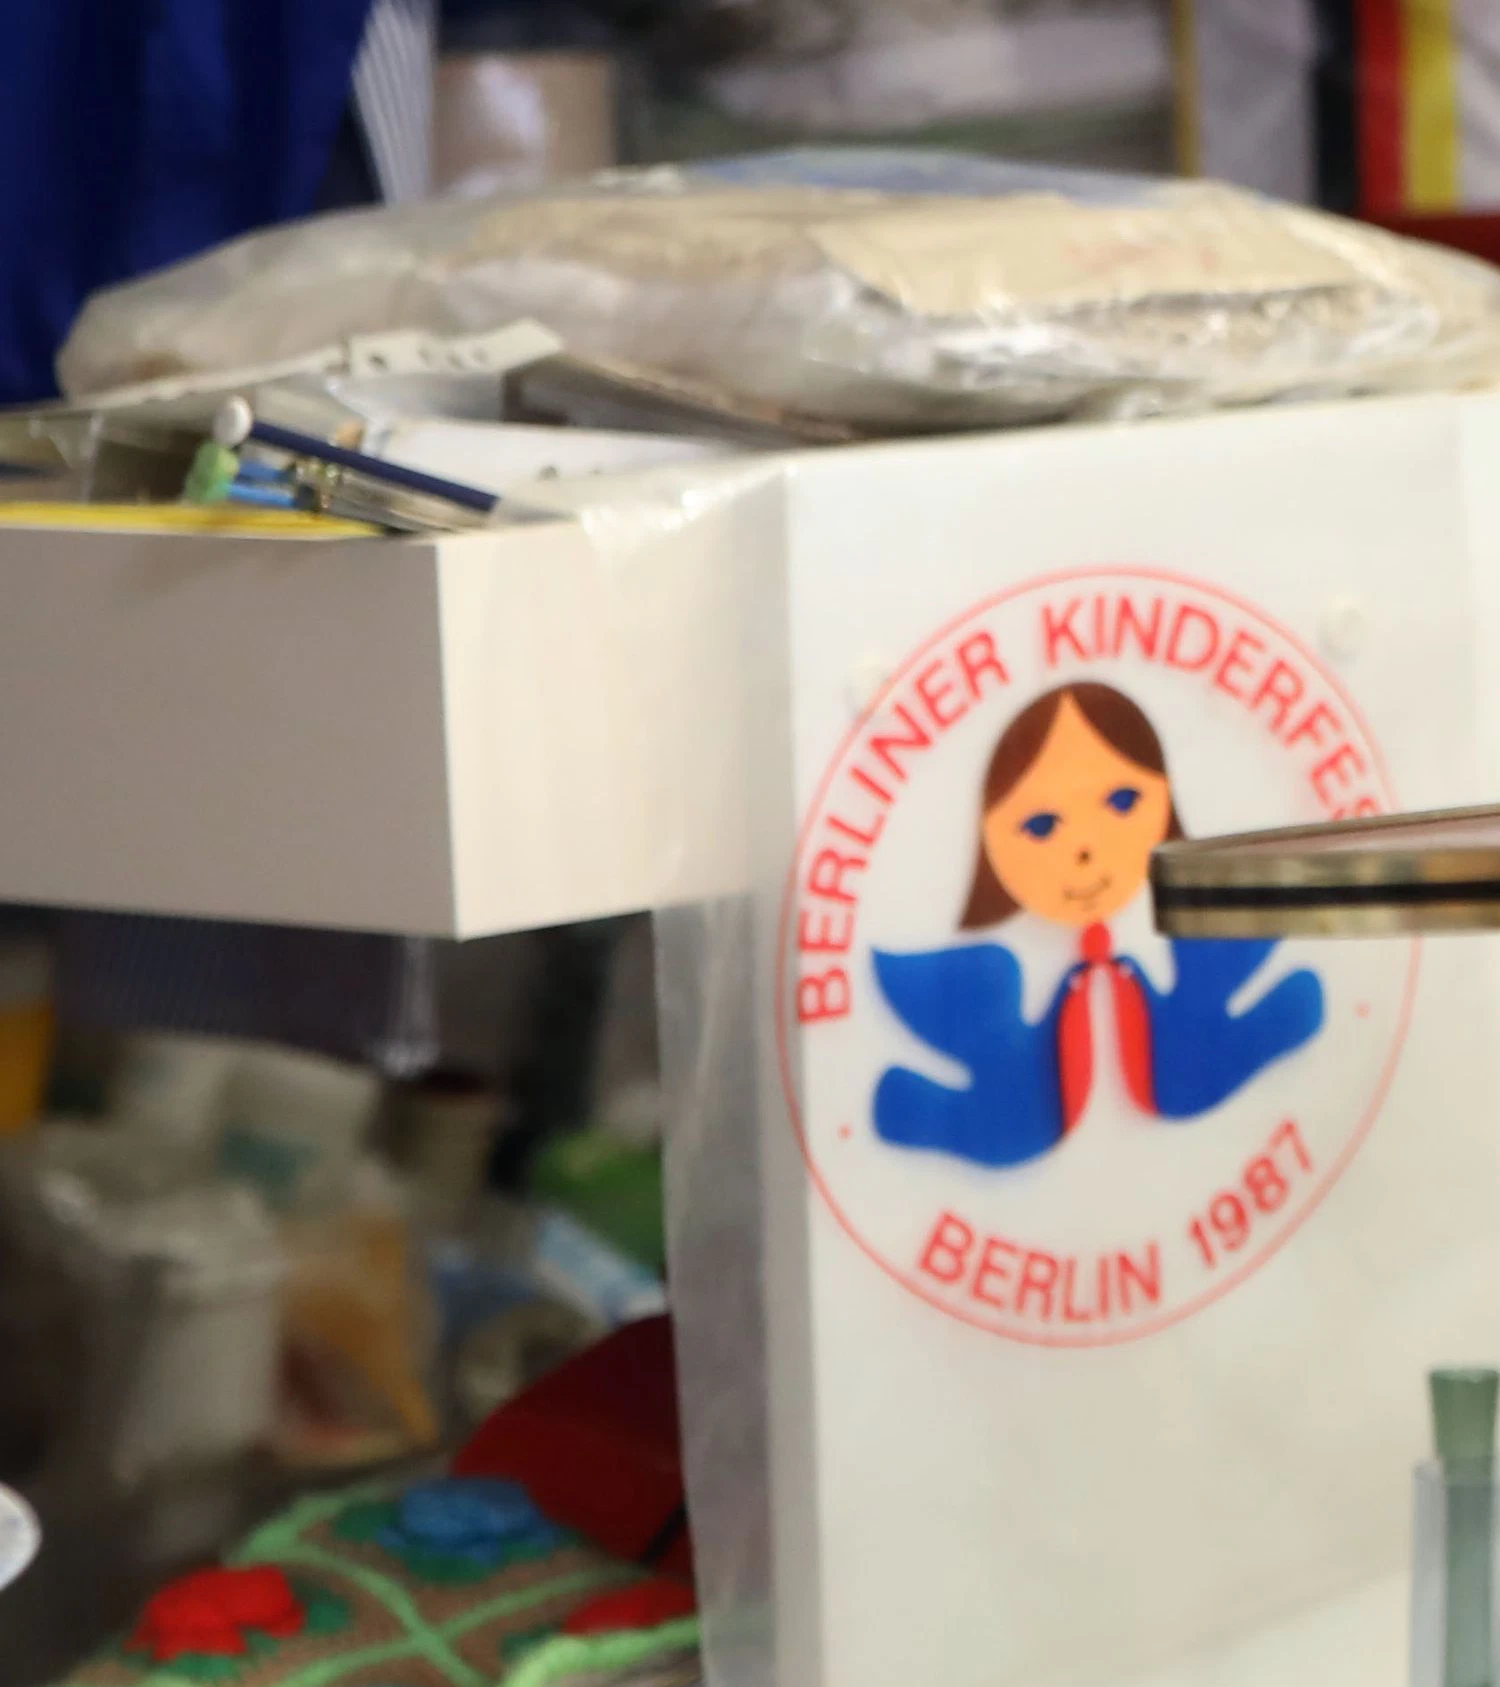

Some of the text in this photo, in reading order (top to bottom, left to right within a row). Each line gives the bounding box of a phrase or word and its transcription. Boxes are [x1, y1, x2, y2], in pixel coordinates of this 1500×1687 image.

[797, 596, 1383, 1026] BERLINER KINDERFES
[916, 1117, 1317, 1323] BERLIN 1987
